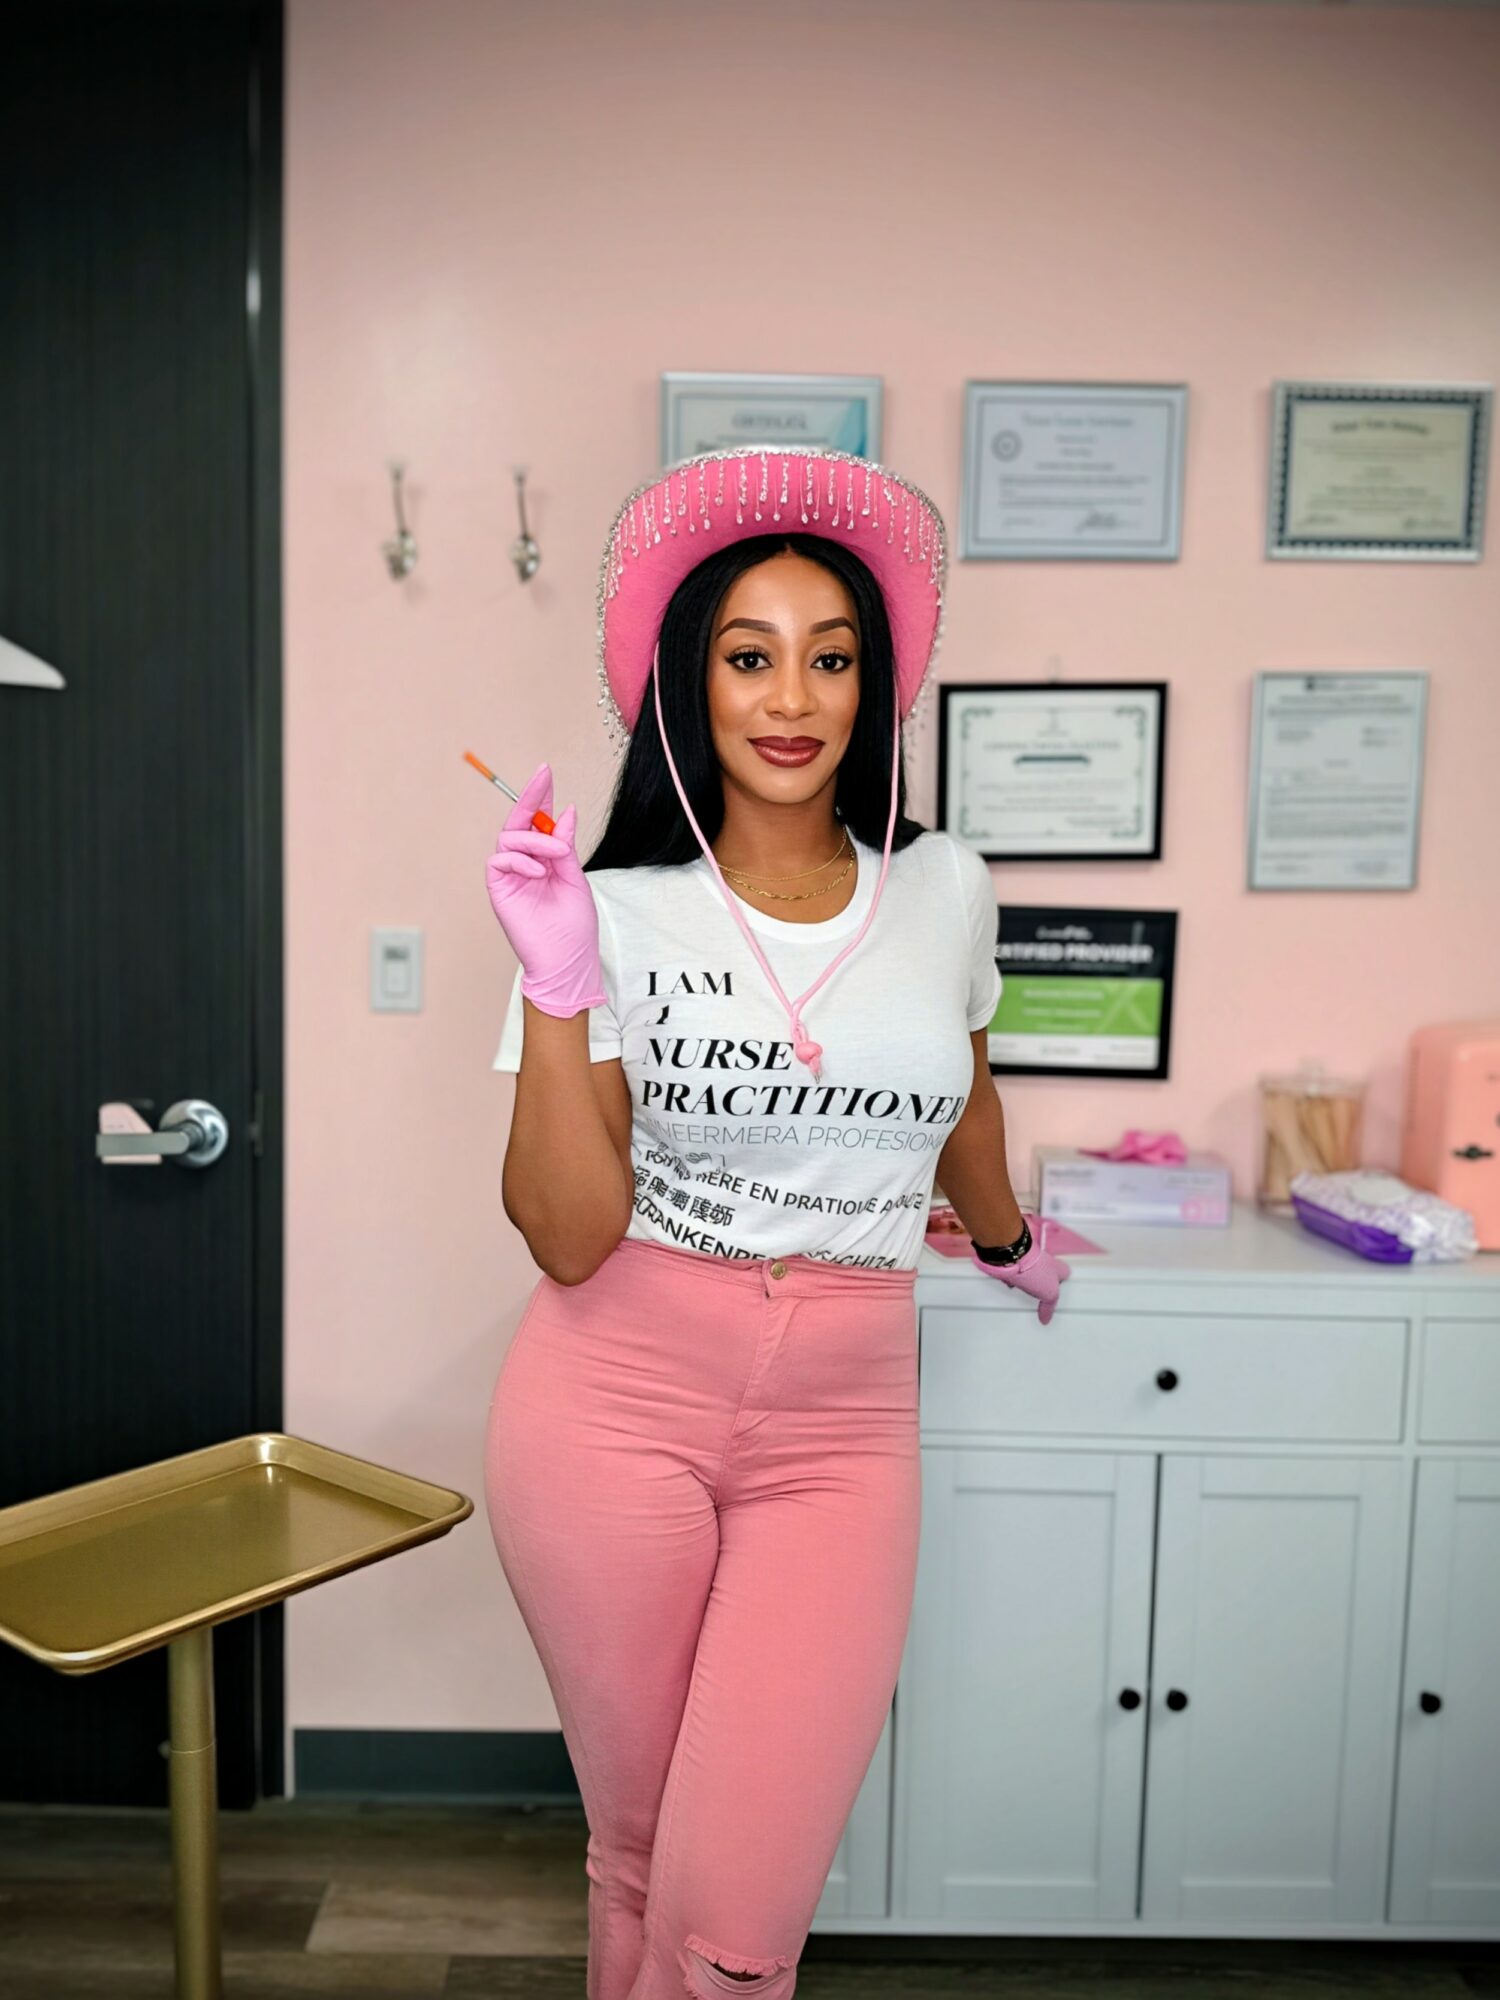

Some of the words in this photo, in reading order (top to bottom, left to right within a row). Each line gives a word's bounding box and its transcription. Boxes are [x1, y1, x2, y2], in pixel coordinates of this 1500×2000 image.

[1064, 943, 1154, 963] PROVIDER
[647, 971, 658, 997] I
[670, 970, 735, 997] AM
[642, 1038, 794, 1071] NURSE
[641, 1080, 965, 1124] PRACTITIONER
[749, 1182, 779, 1204] EN
